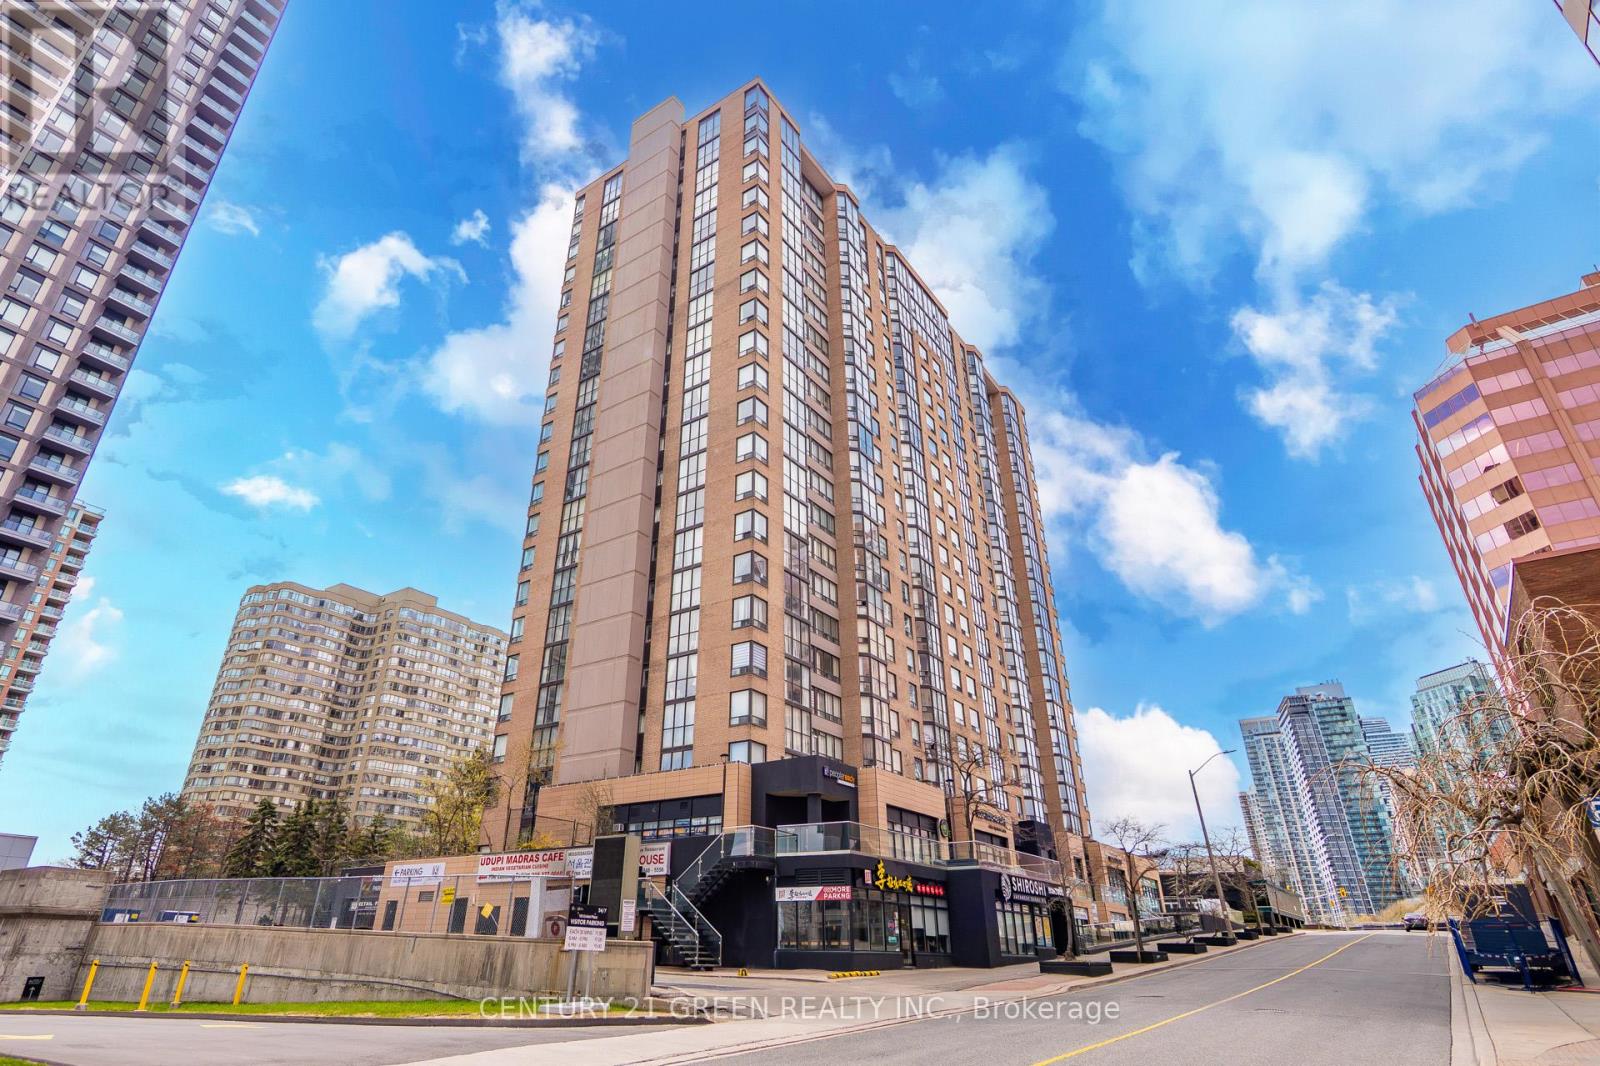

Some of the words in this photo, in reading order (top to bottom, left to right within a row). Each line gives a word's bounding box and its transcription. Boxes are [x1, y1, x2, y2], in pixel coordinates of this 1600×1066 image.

[480, 857, 504, 866] UDUPI
[506, 853, 540, 864] MADRAS
[542, 851, 564, 862] CAFE
[639, 853, 664, 865] OUSE
[400, 868, 423, 877] PARKING
[1011, 877, 1047, 897] SHIROSHI
[586, 919, 605, 927] PARKING
